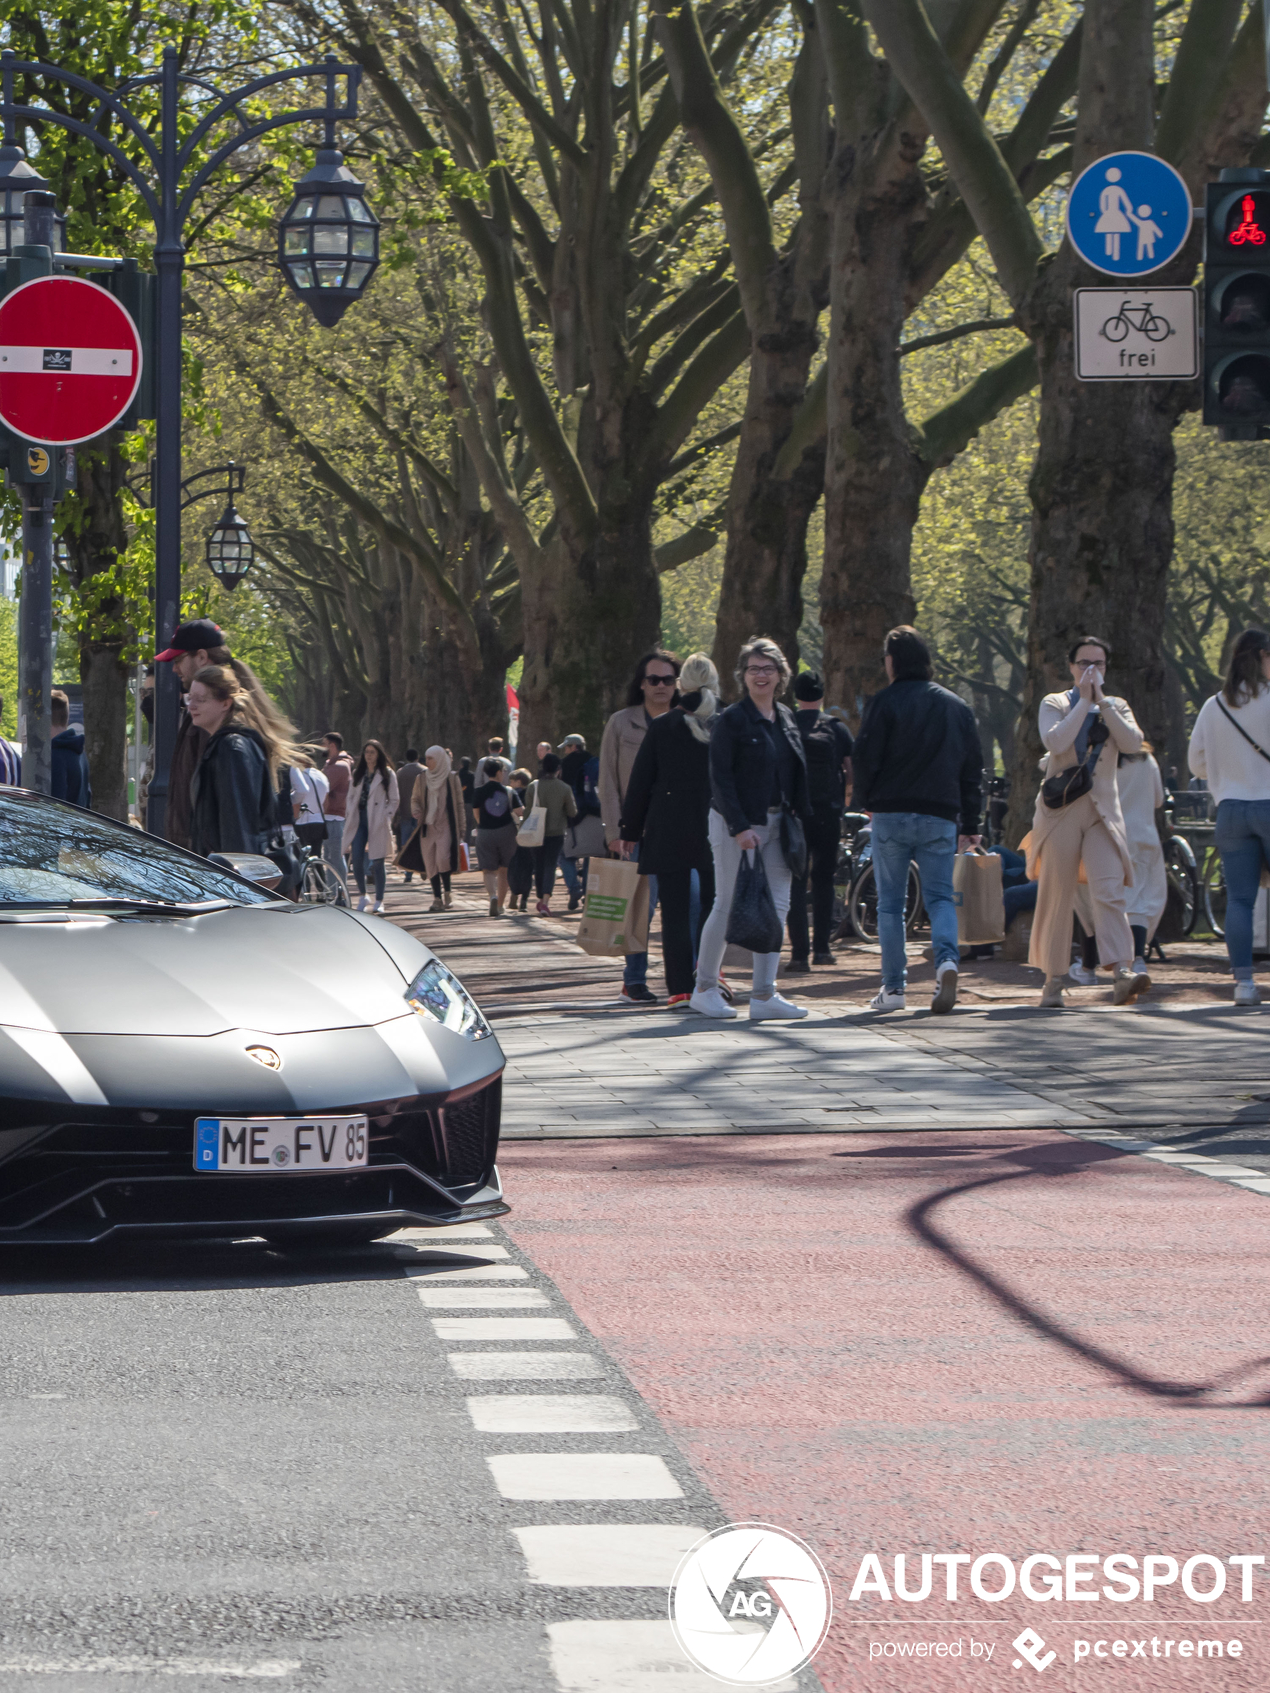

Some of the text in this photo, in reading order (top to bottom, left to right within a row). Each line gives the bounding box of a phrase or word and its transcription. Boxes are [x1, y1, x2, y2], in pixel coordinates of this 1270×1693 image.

[1119, 348, 1156, 367] frei
[221, 1122, 366, 1165] ME FV 85
[202, 1149, 214, 1161] D
